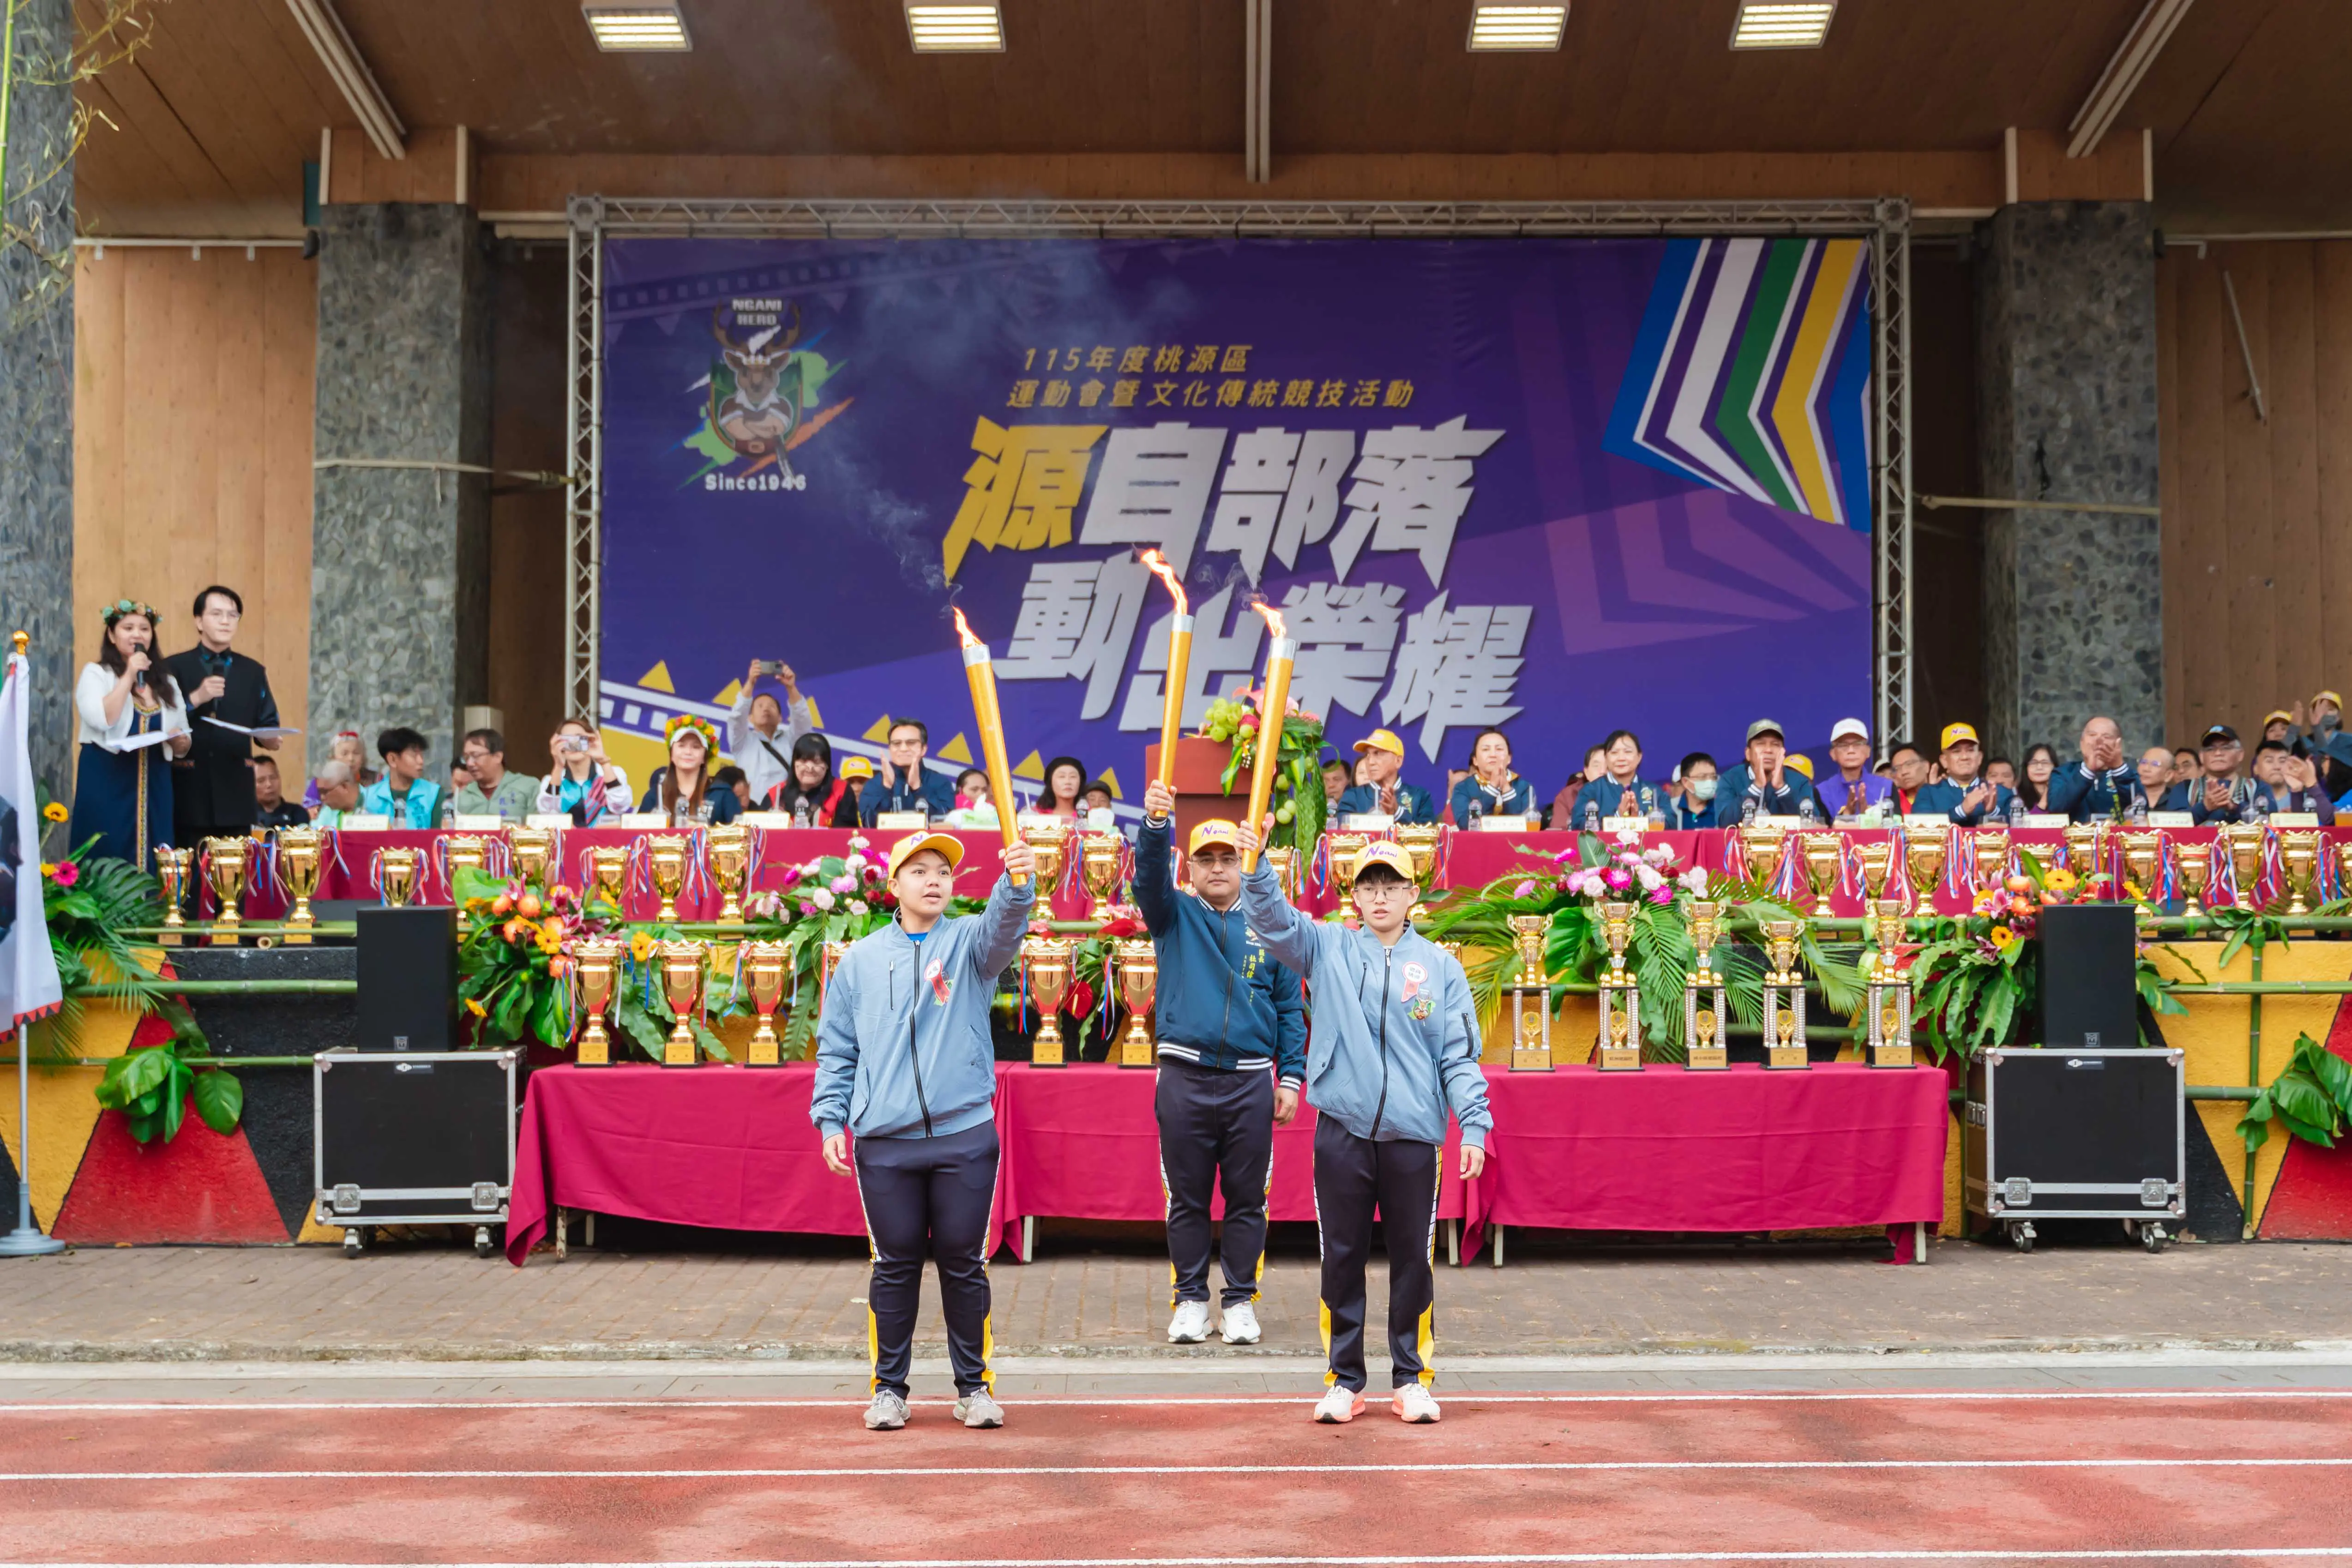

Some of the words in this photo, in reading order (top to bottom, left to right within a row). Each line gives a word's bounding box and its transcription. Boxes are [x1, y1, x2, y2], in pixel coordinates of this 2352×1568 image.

[732, 299, 782, 311] NGANI
[737, 314, 776, 325] HERO
[1024, 345, 1252, 372] 115年度桃源區
[1006, 379, 1414, 408] 運動會暨文化傳統競技活動
[705, 472, 806, 491] Since1946
[942, 415, 1506, 590] 源自部落
[993, 543, 1533, 764] 動出榮耀
